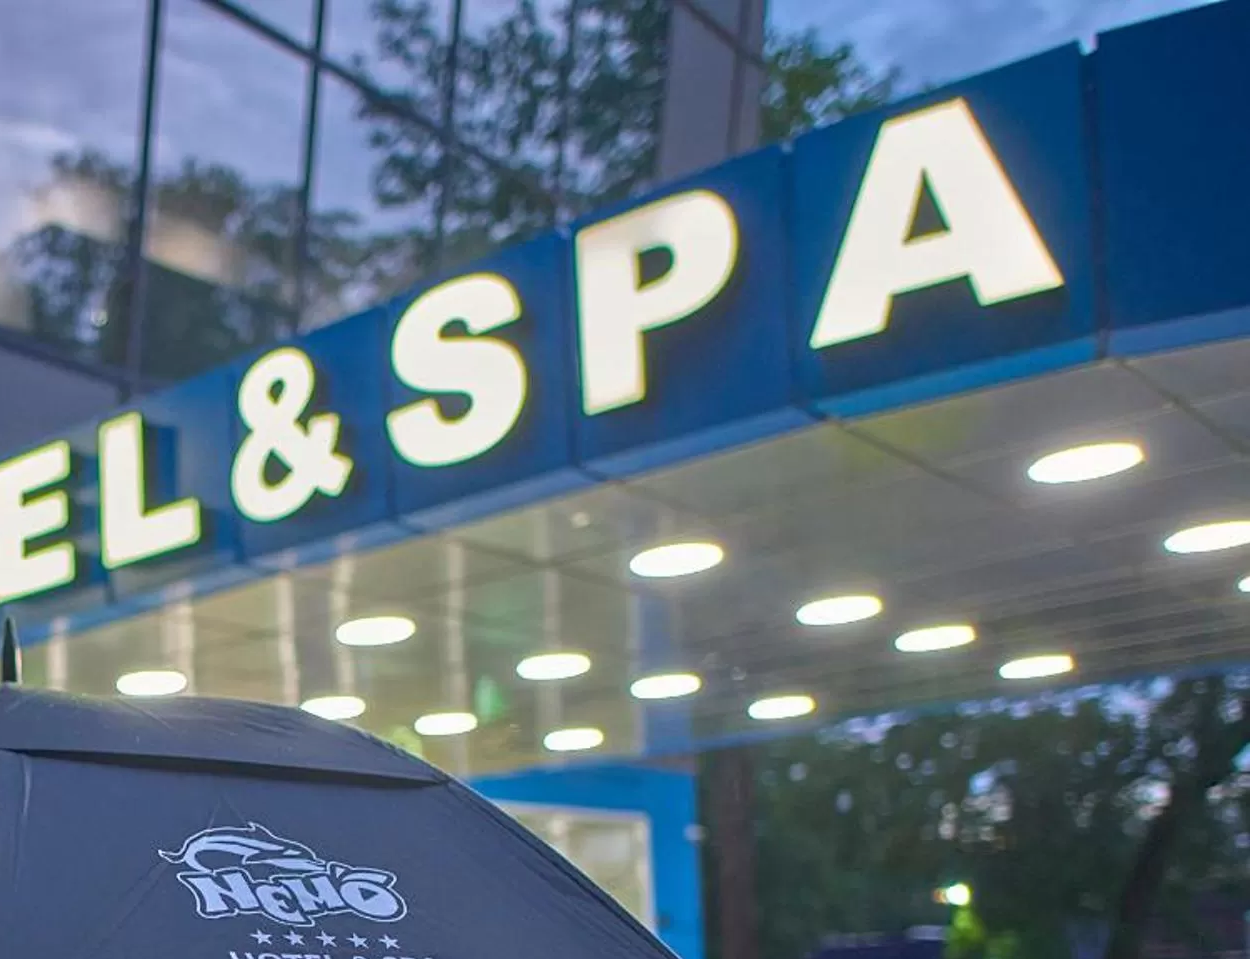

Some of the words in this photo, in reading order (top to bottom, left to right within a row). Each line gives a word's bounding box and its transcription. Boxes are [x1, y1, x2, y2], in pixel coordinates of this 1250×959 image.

[230, 346, 354, 523] &
[385, 96, 1065, 469] SPA
[186, 864, 403, 924] NEMO
